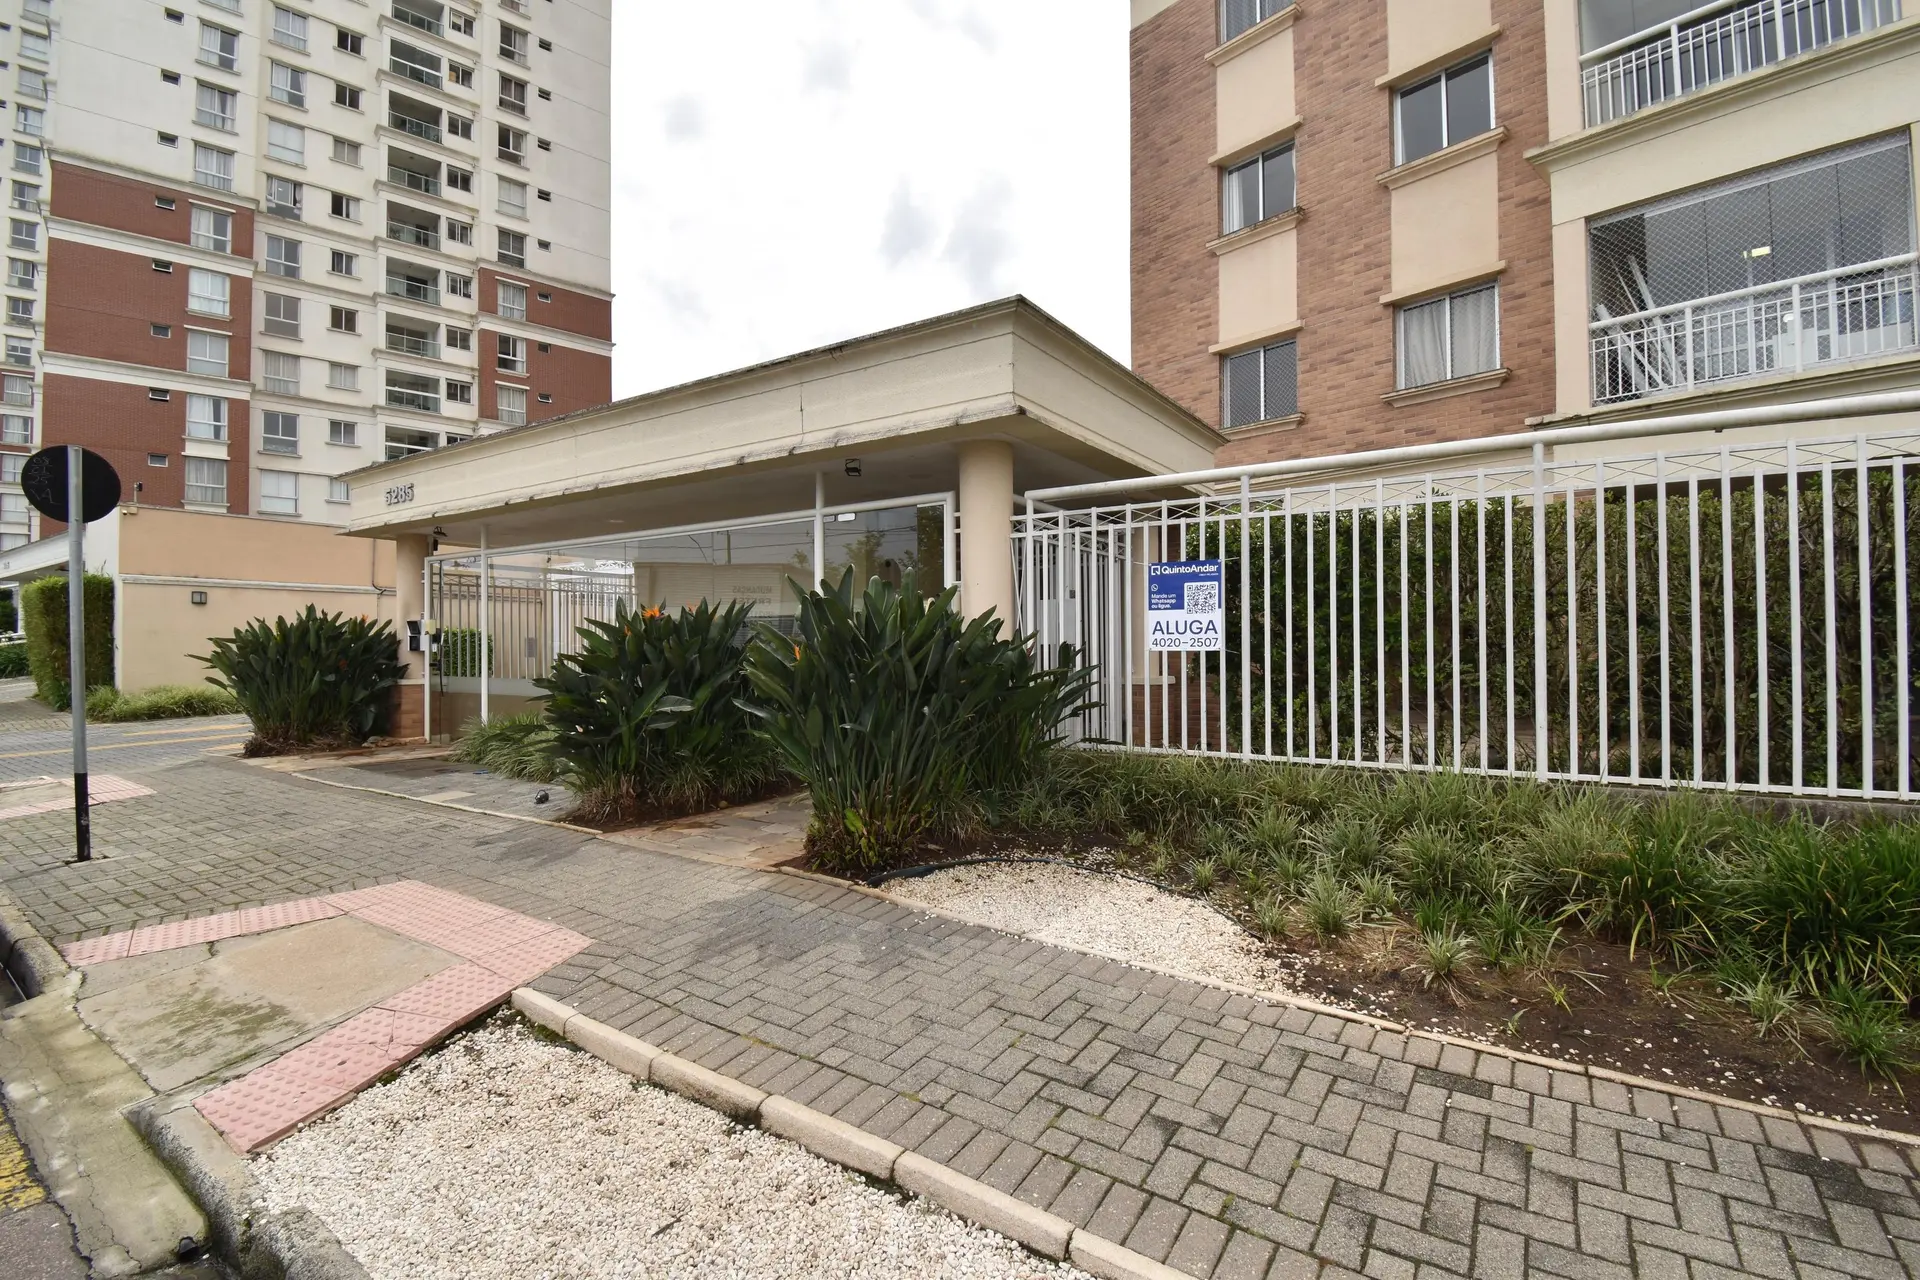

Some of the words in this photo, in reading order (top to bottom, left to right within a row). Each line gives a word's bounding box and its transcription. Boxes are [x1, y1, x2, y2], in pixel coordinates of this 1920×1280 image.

[384, 483, 414, 506] 5285
[1161, 564, 1218, 574] QuintoAndar
[1152, 620, 1218, 635] ALUGA
[1152, 638, 1218, 648] 4020-2507
